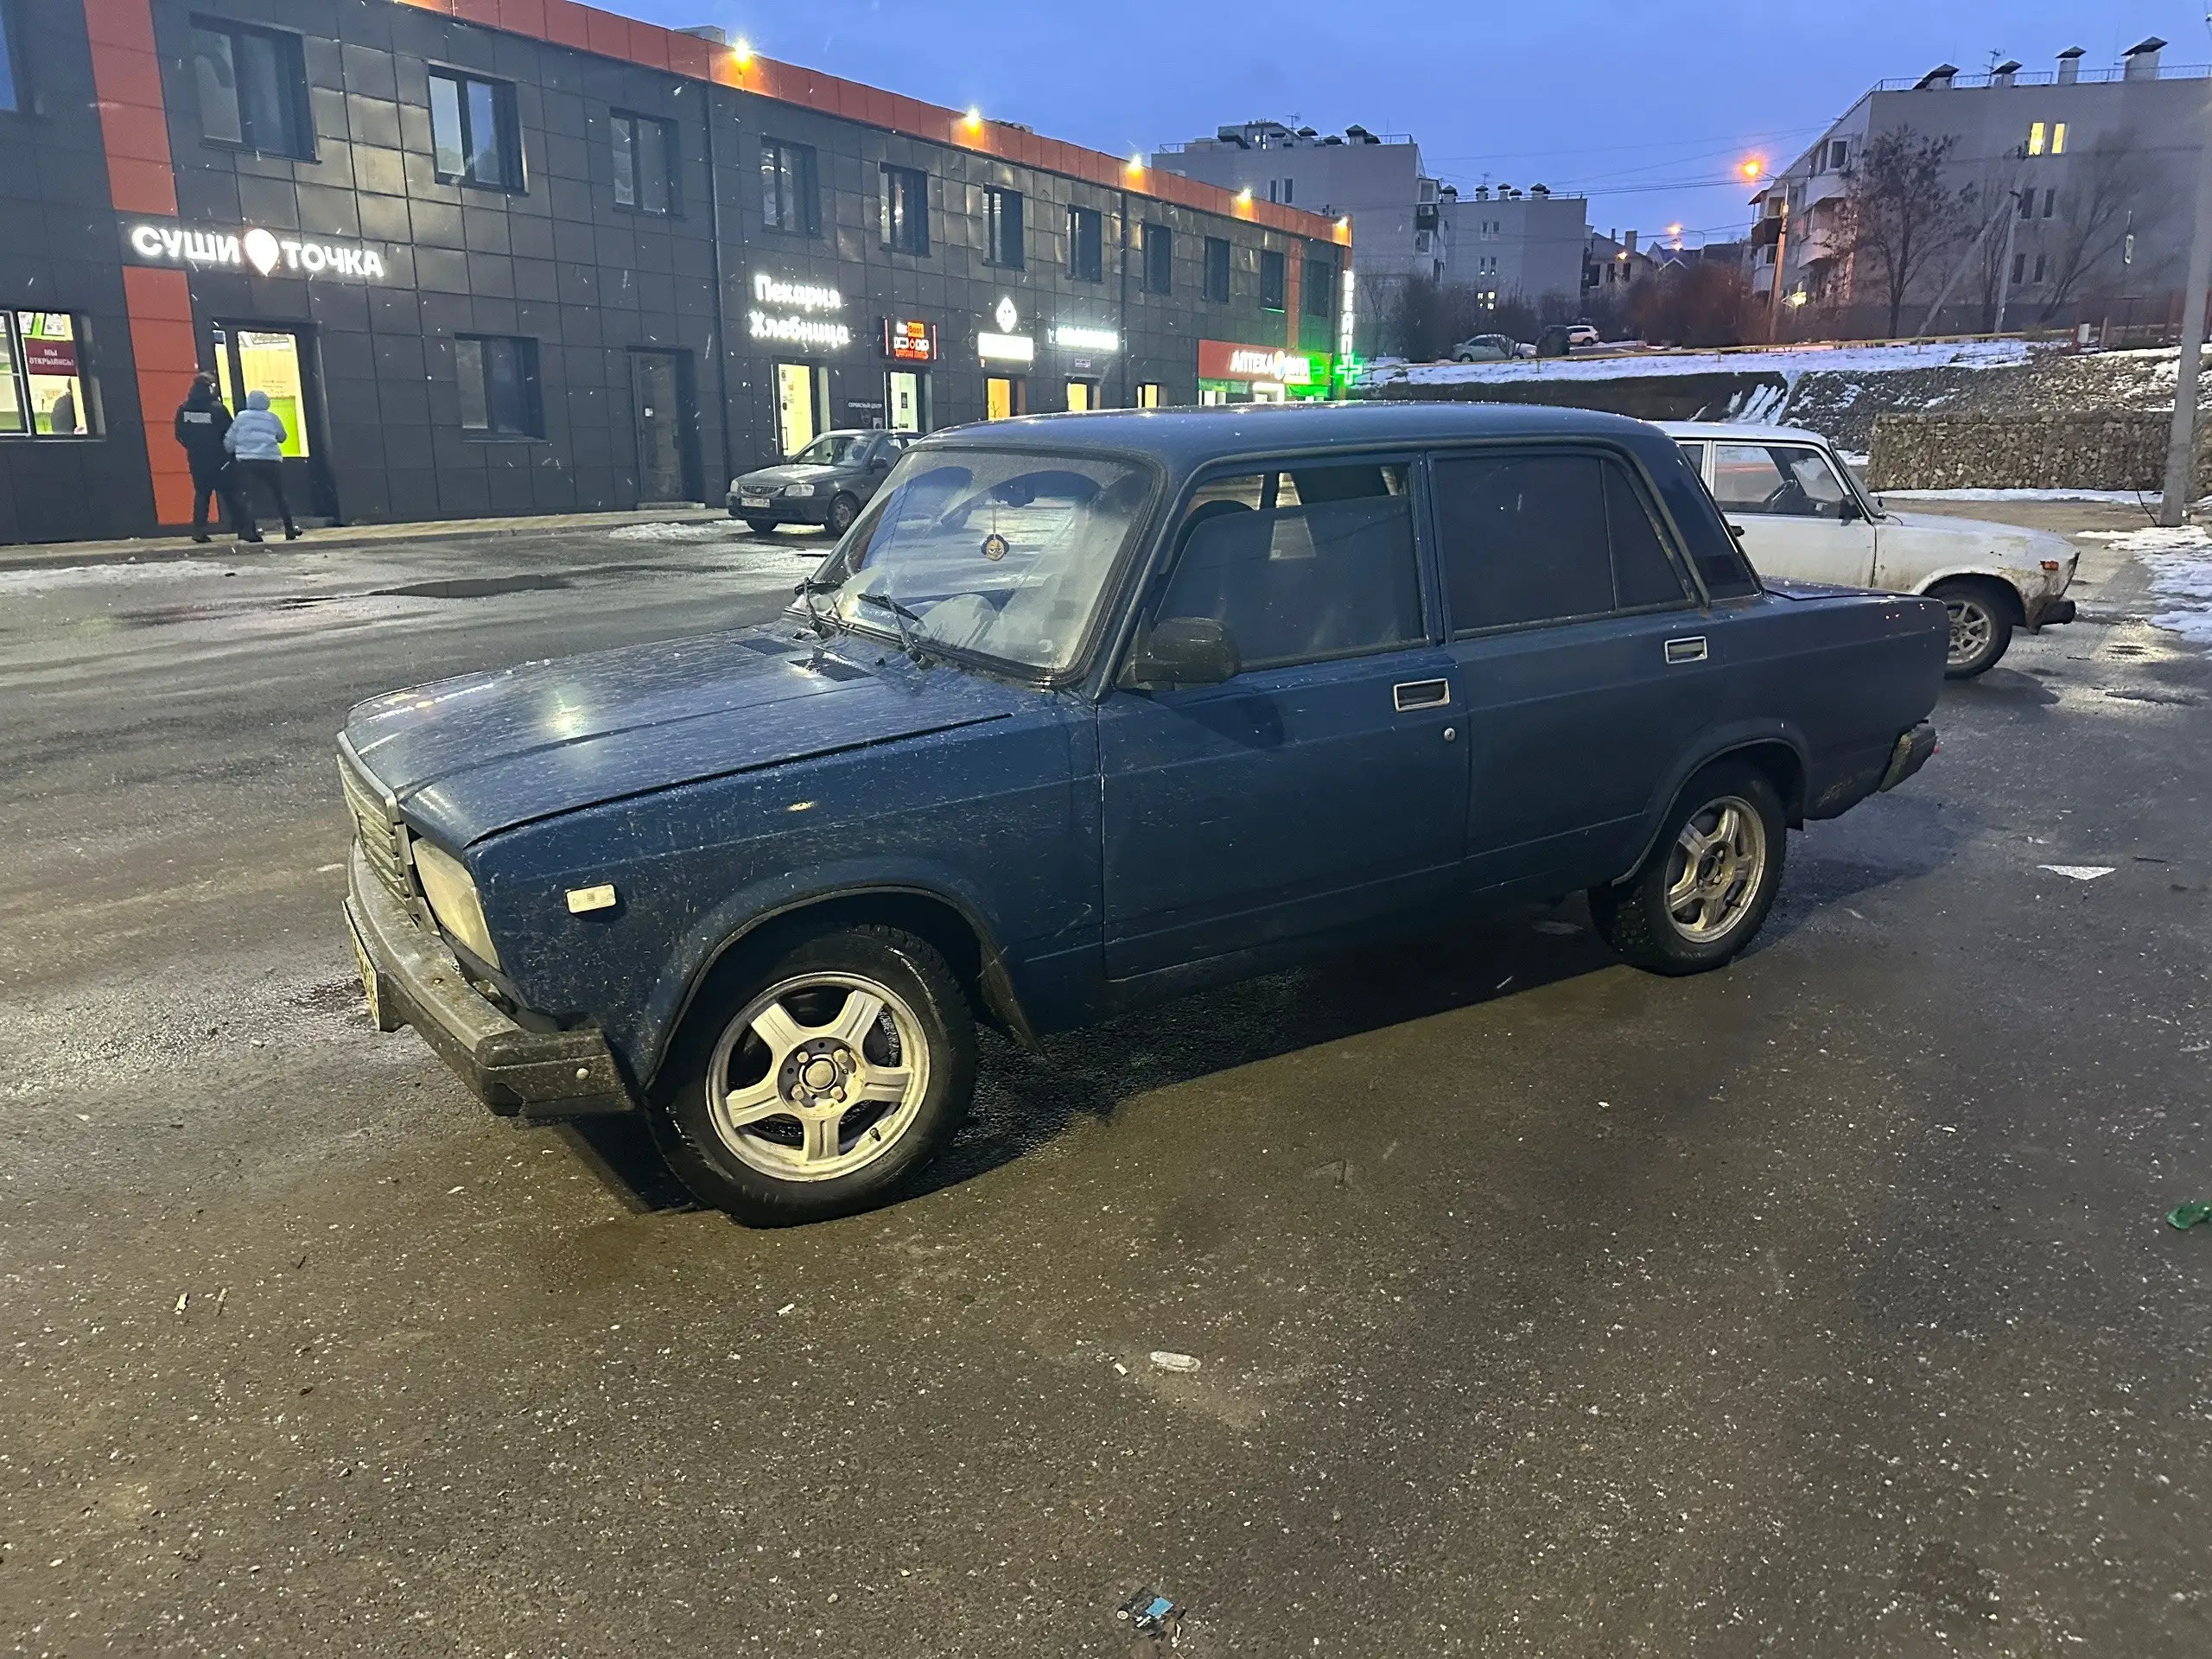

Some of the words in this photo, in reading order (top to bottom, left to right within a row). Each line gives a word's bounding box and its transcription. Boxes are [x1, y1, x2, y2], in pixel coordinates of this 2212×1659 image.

[132, 226, 240, 263] СУШИ
[279, 240, 385, 277] ТОЧКА
[748, 311, 850, 348] Хлебница
[43, 348, 58, 357] МЫ
[1232, 350, 1274, 373] АПТЕКА
